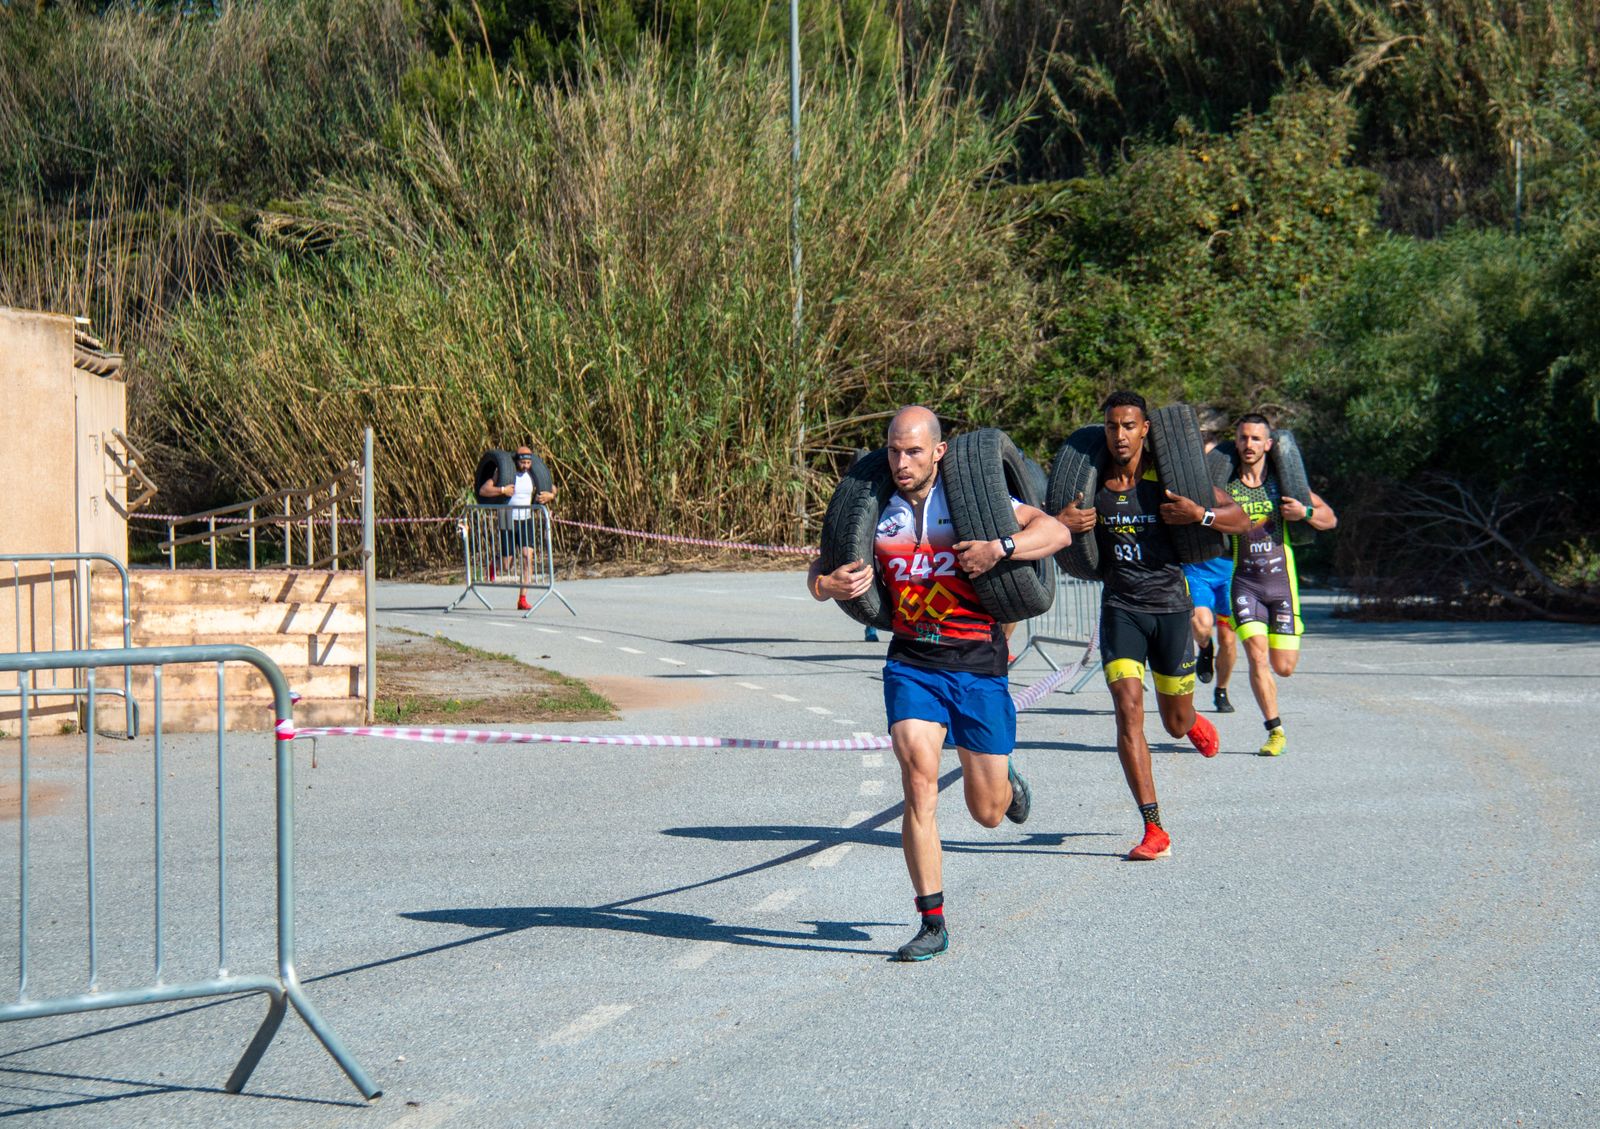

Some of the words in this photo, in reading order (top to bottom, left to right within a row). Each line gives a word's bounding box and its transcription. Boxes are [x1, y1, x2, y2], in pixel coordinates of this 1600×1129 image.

[1241, 501, 1273, 514] 1153
[1114, 544, 1142, 561] 931
[888, 552, 956, 582] 242
